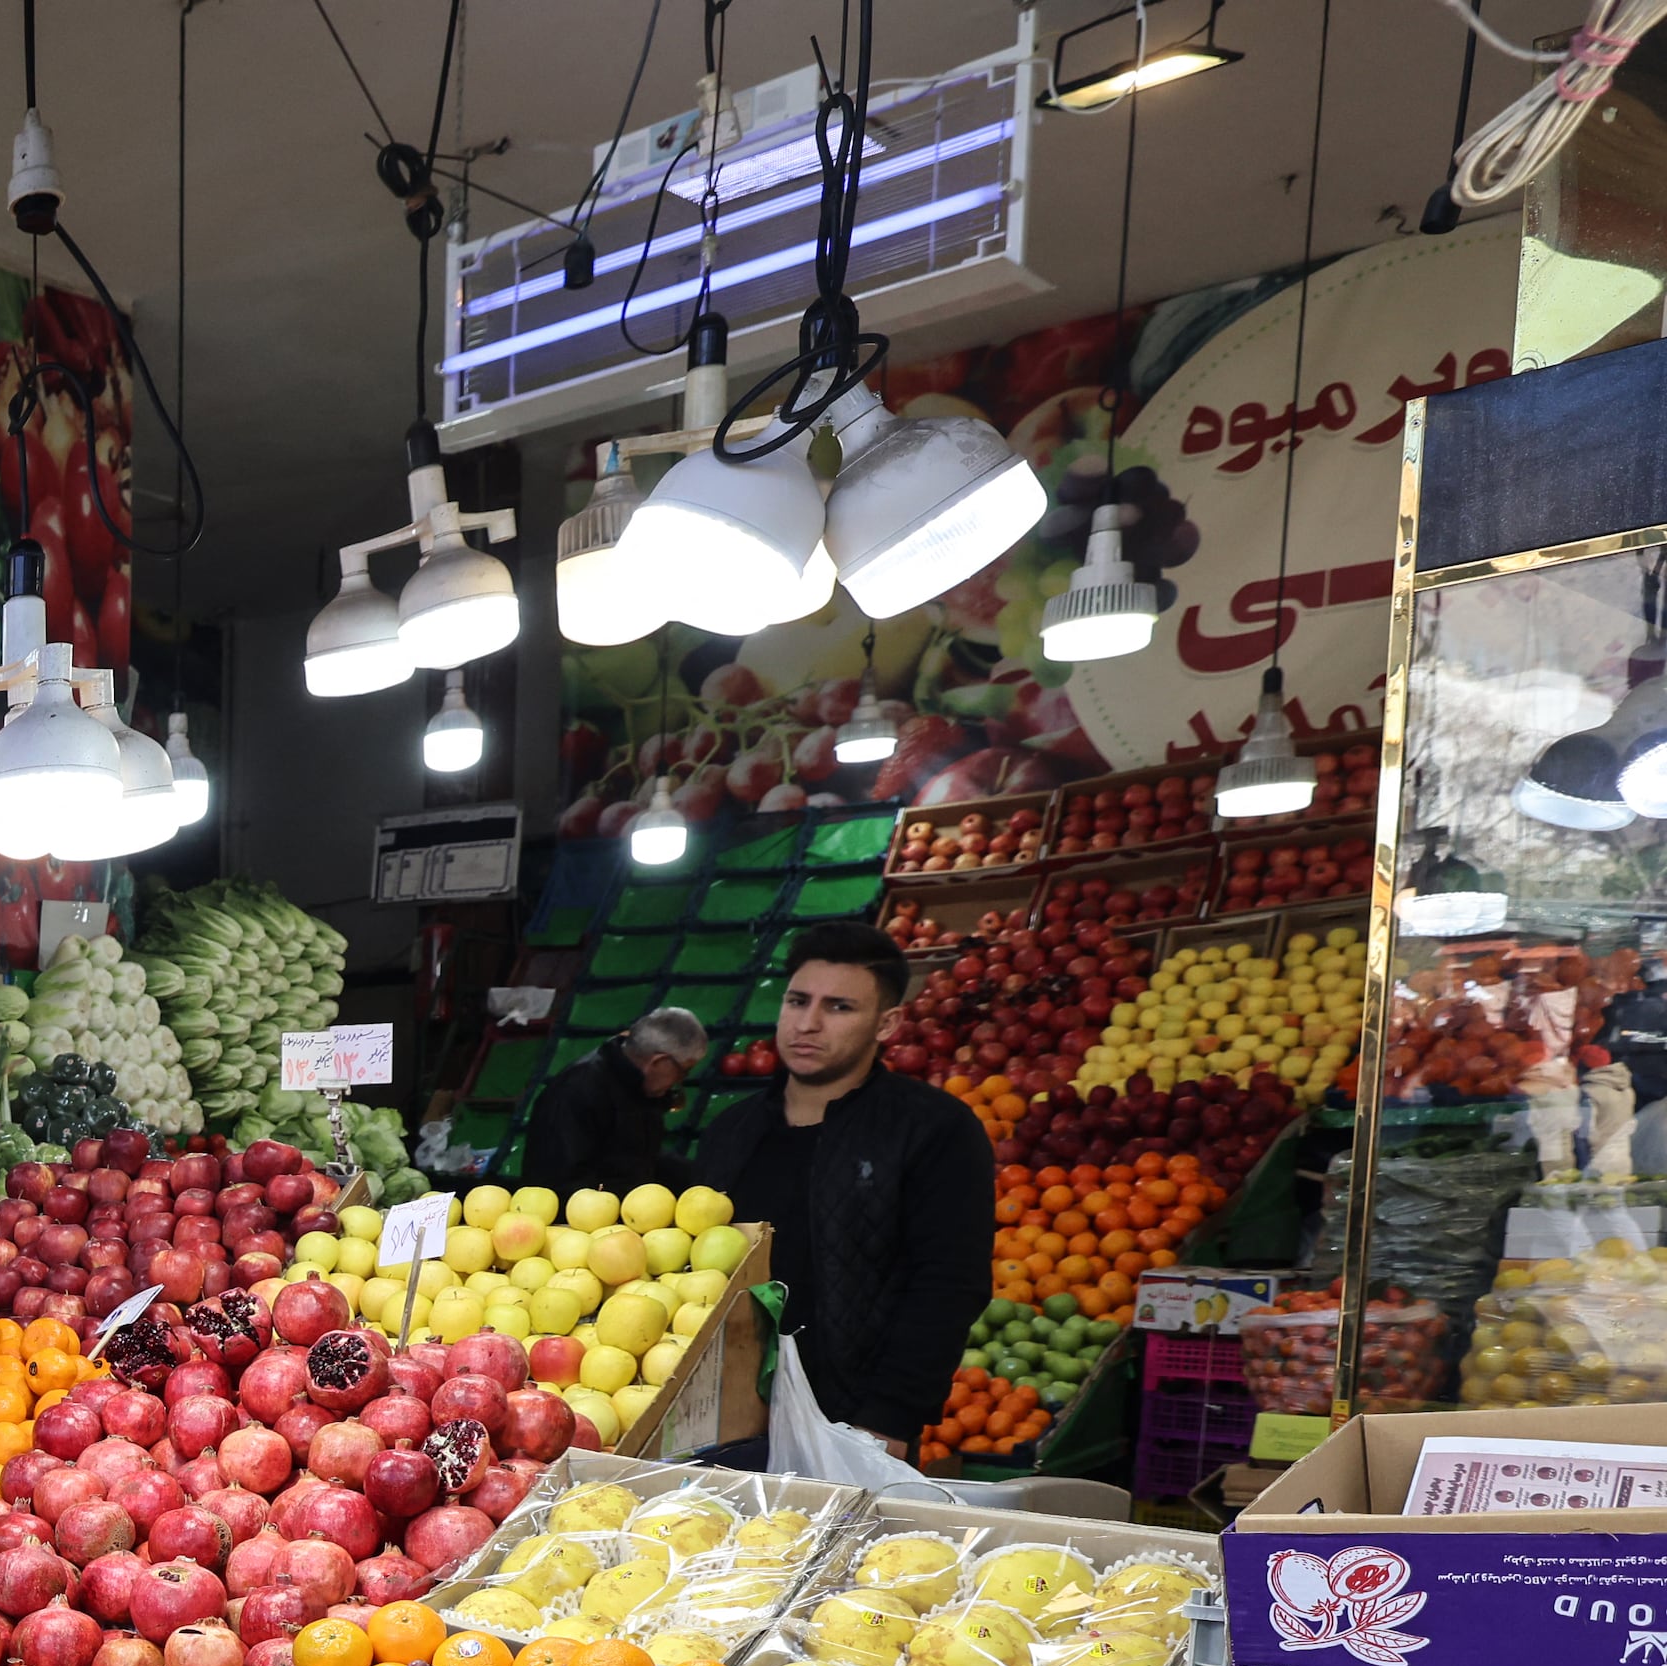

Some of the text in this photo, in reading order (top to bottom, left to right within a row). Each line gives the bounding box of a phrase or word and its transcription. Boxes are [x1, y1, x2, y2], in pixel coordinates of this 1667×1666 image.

[1182, 348, 1513, 472] ور میوه
[1503, 1555, 1536, 1567] برطرف
[1568, 1556, 1613, 1568] مشکلات
[1437, 1573, 1468, 1585] سرشار
[1481, 1573, 1522, 1585] ویتامین
[1598, 1575, 1635, 1588] تقویت
[1636, 1576, 1667, 1588] اعصا
[1552, 1594, 1667, 1628] OUD
